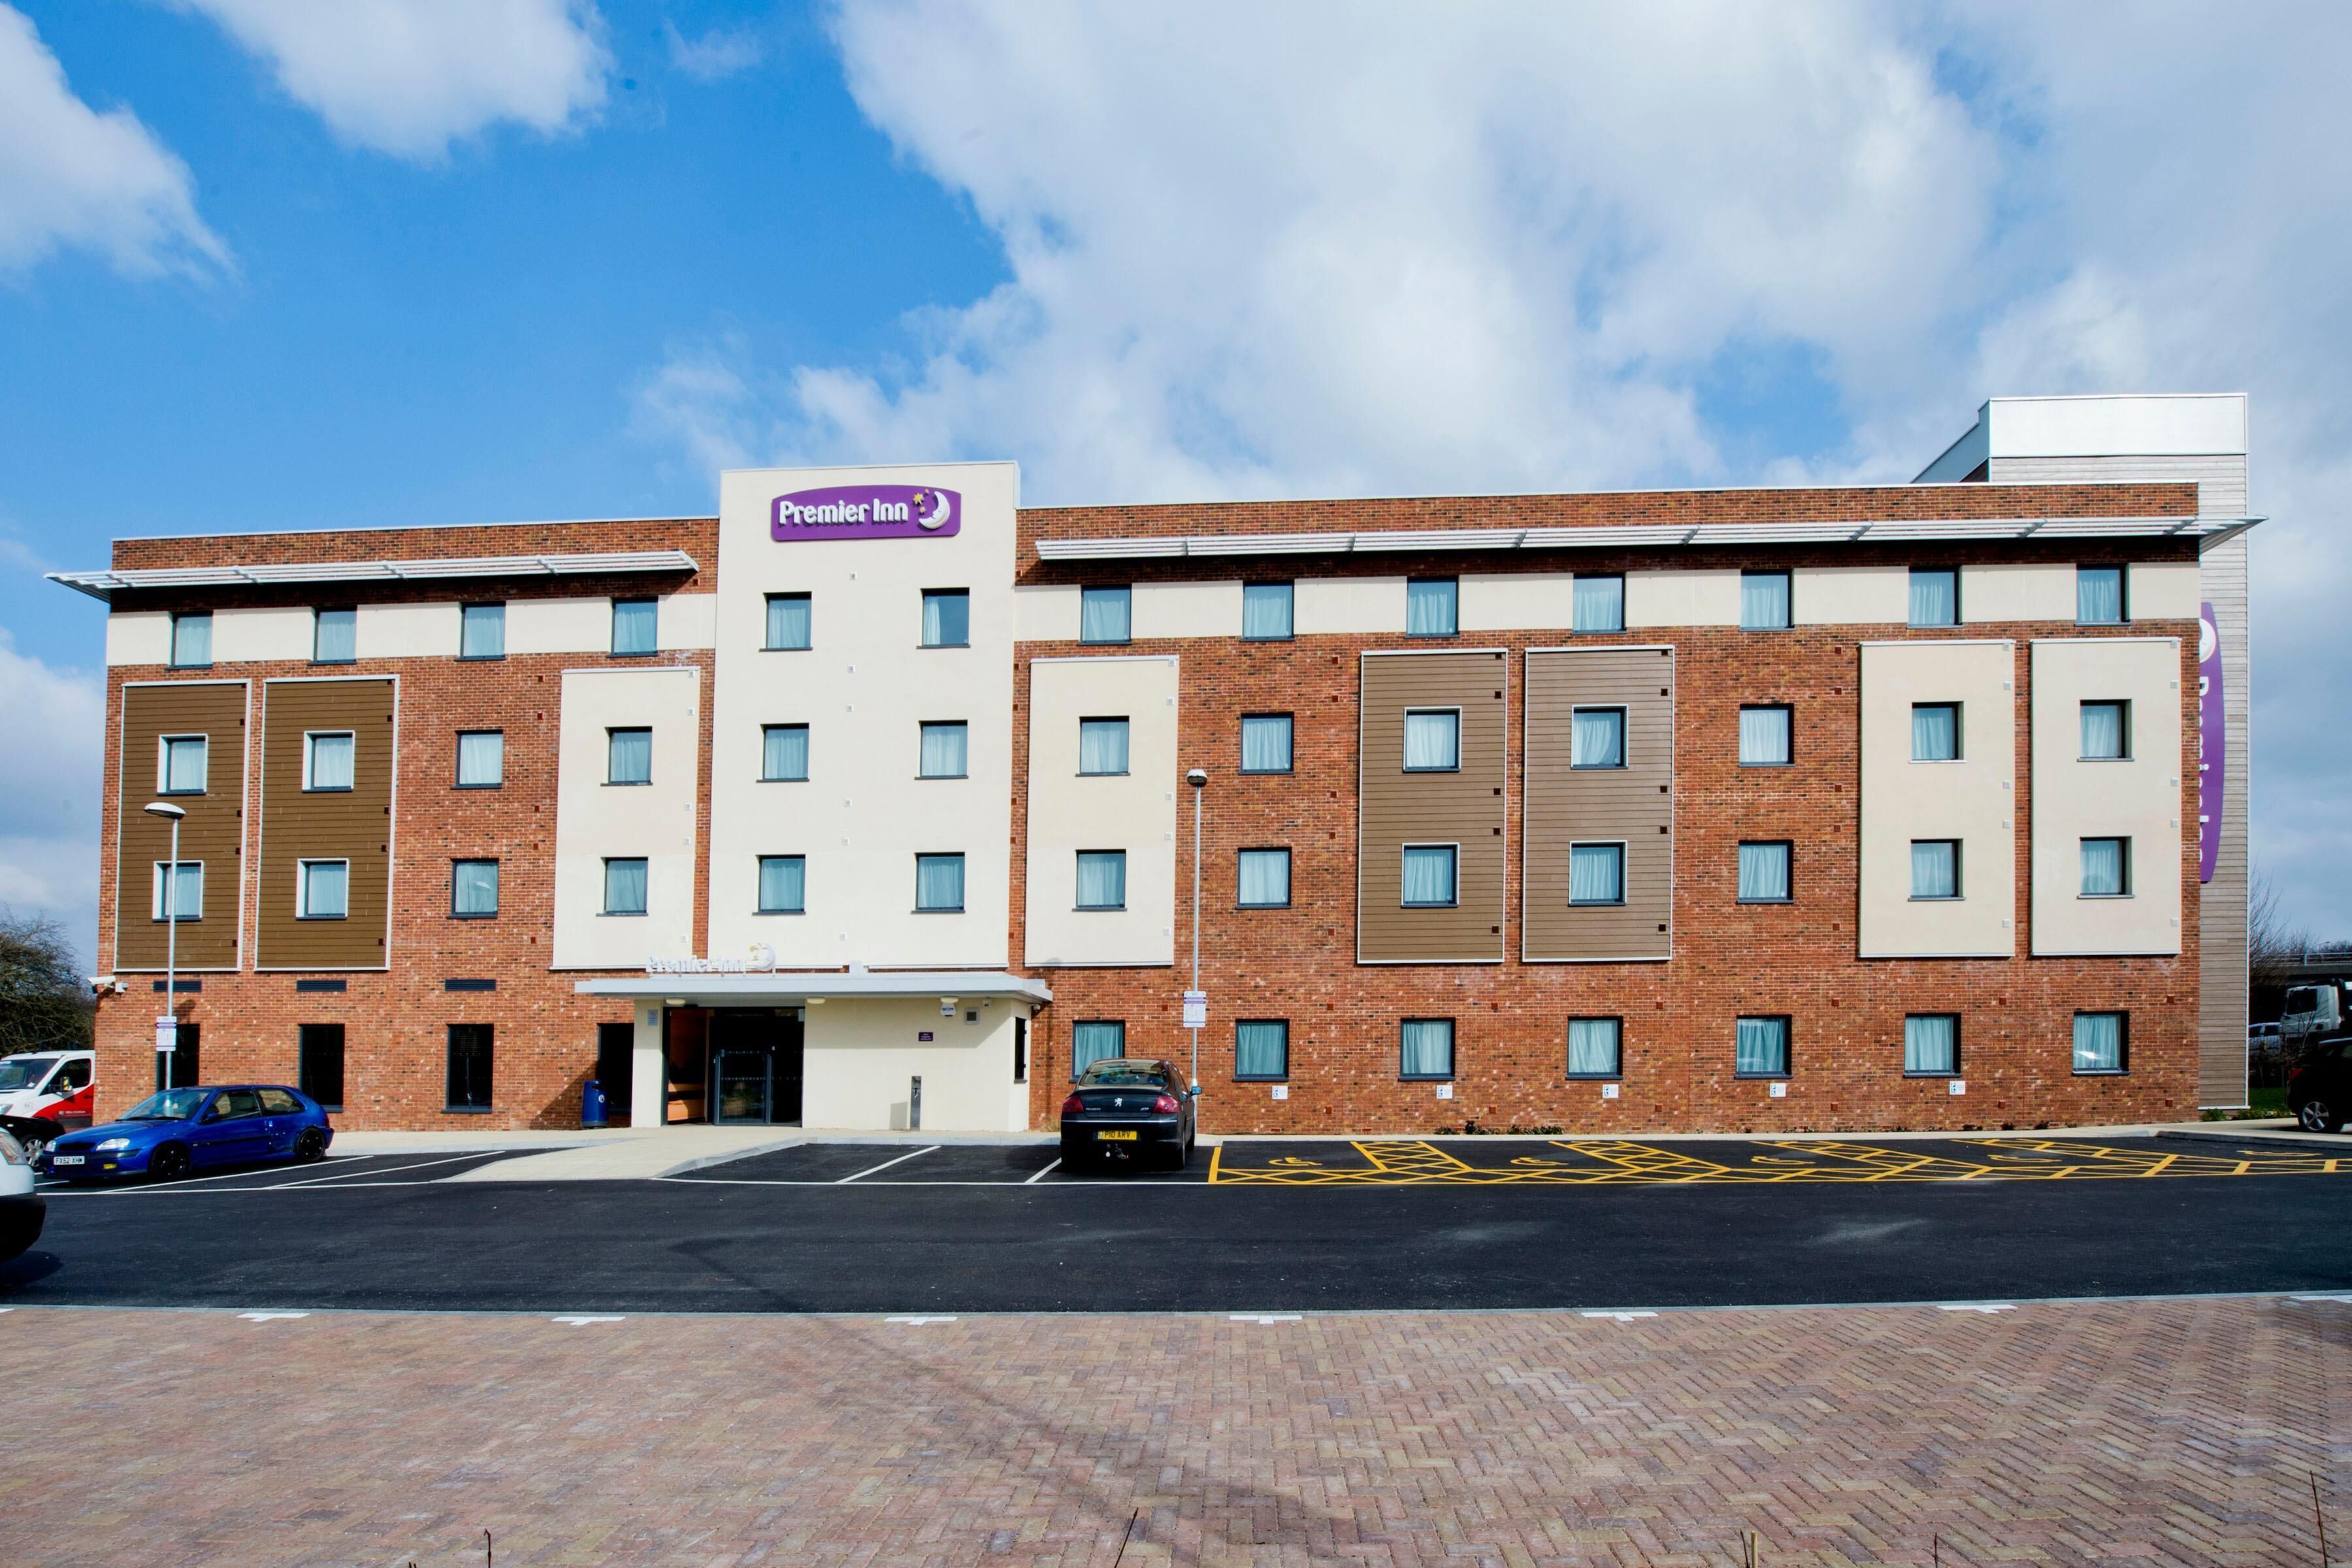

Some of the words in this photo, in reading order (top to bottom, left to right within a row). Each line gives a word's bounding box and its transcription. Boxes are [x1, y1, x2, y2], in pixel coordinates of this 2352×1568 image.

[779, 499, 870, 525] Premier
[873, 498, 908, 522] Inn
[645, 955, 715, 972] Premier
[1117, 1130, 1131, 1139] ARV
